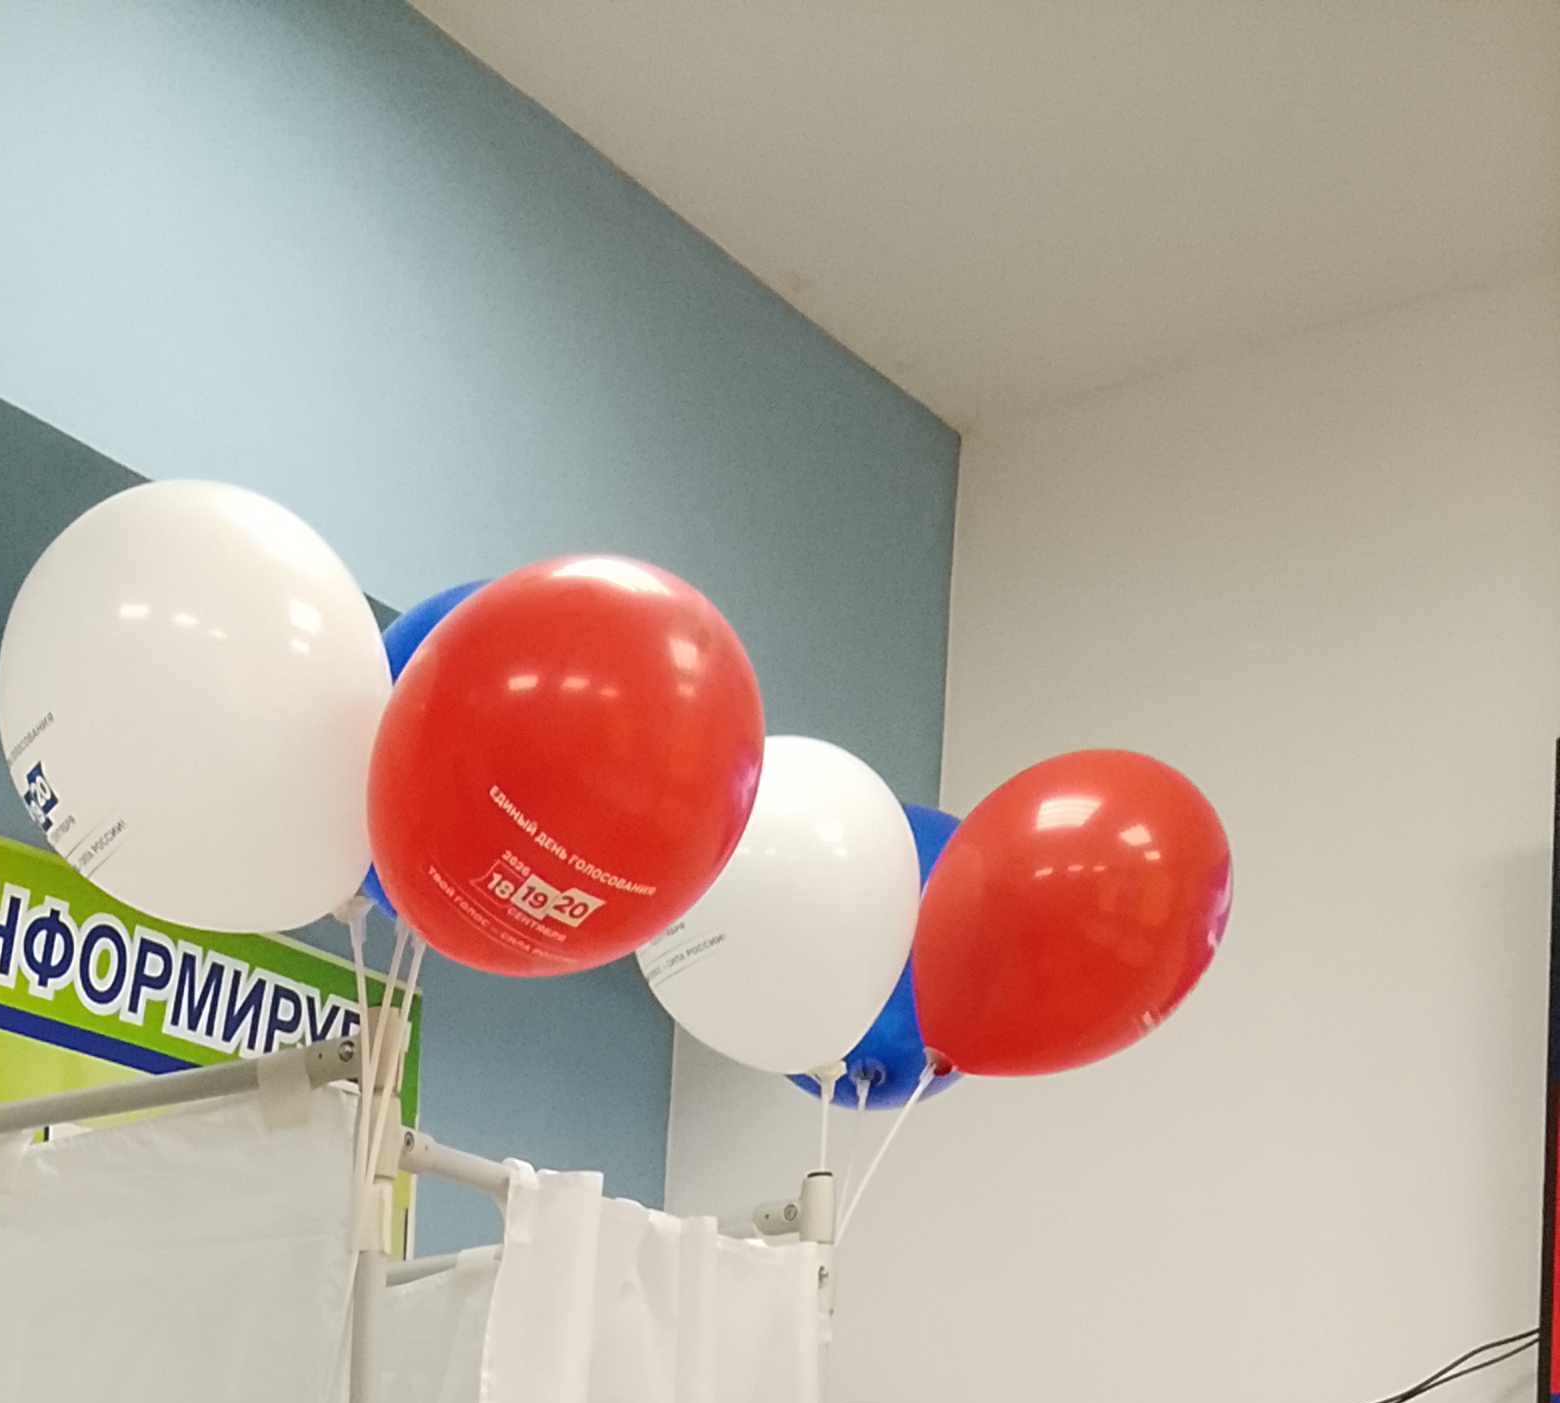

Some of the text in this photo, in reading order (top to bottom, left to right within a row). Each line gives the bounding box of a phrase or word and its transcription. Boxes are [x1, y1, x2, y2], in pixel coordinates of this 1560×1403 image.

[30, 775, 51, 808] 20
[489, 784, 657, 897] ЕДИНЫЙ ДЕНЬ ГОЛОСОВАНИЯ
[501, 849, 532, 877] 2026
[453, 895, 491, 927] ГОЛОС
[487, 872, 590, 920] 18 19 20
[507, 906, 567, 943] СЕНТЯБРЯ
